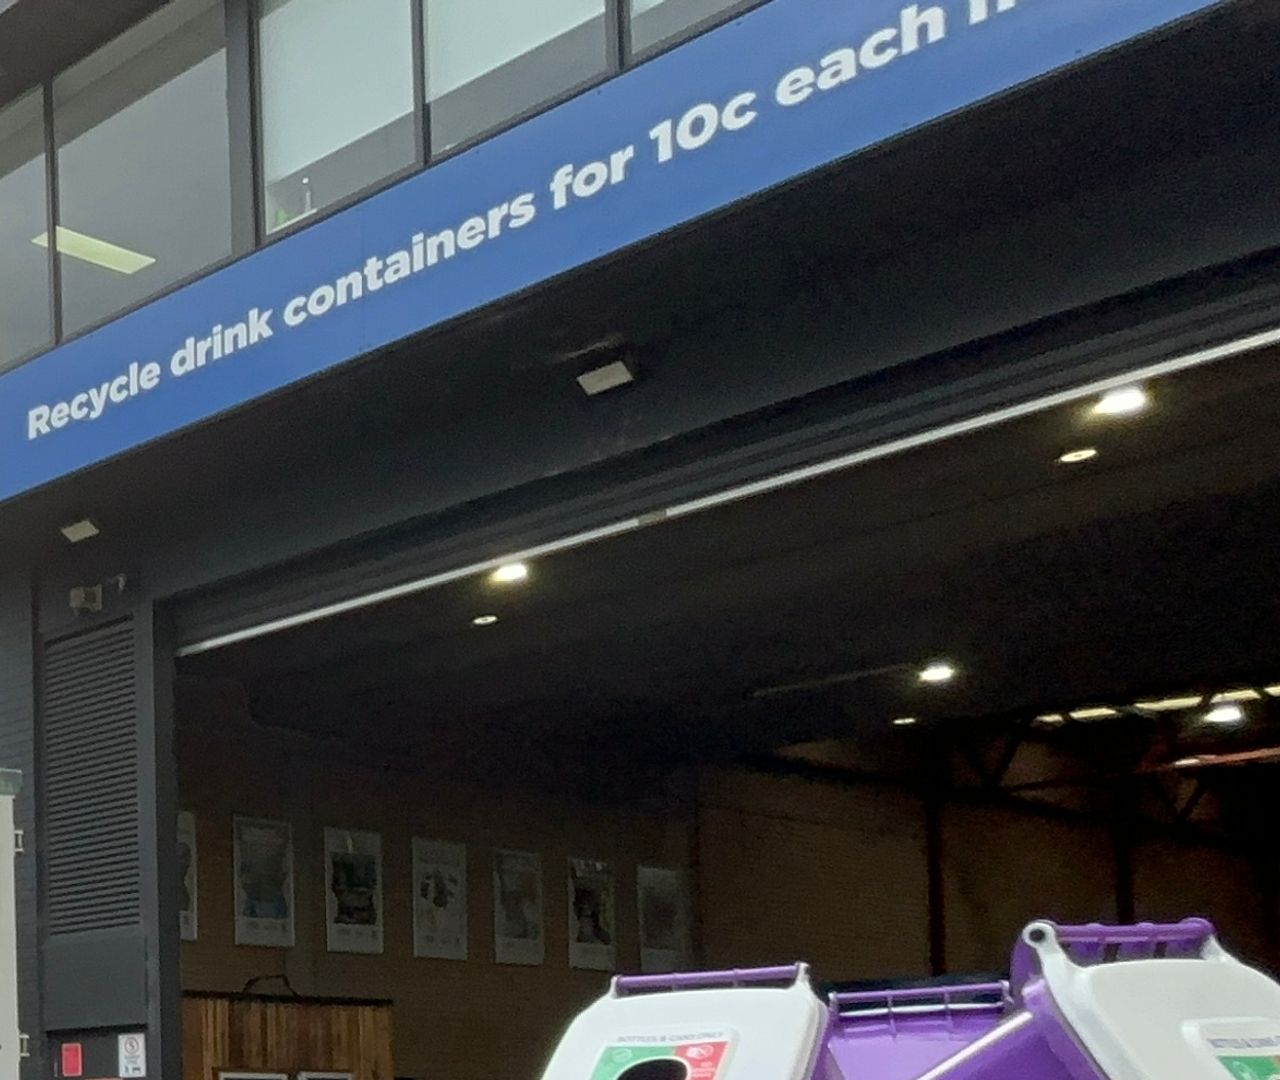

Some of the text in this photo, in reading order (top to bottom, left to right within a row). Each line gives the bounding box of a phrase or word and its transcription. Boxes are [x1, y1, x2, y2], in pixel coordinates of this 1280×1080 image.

[27, 2, 945, 441] Recycle drink containers for 10c each
